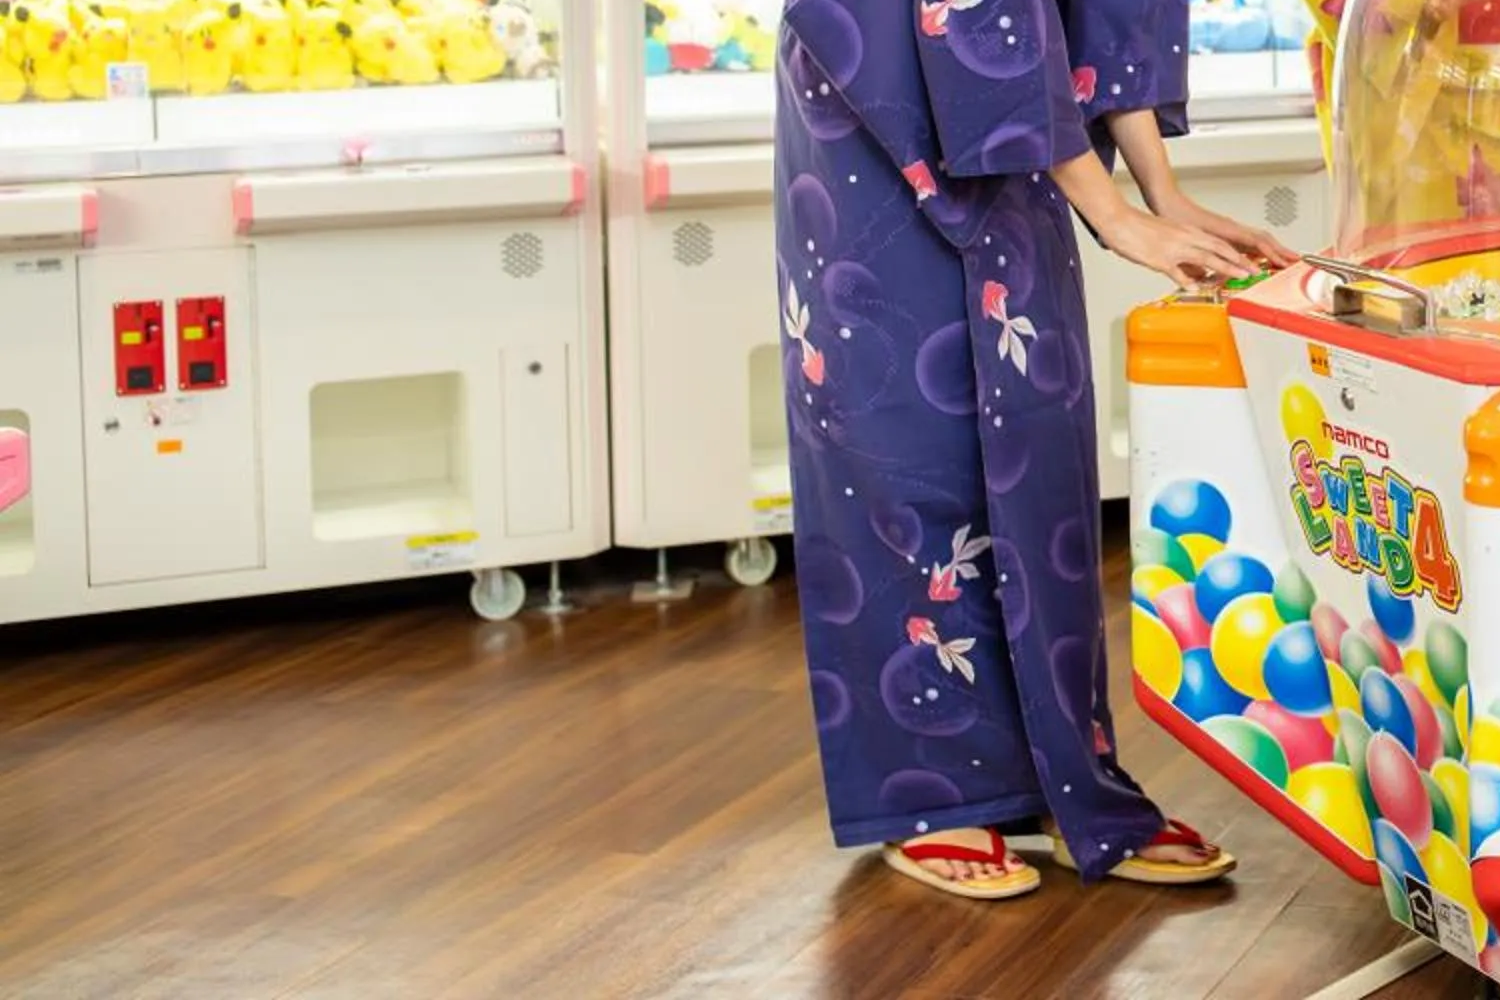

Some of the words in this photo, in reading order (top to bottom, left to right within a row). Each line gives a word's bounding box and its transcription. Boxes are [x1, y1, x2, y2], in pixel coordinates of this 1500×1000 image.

[1321, 421, 1390, 460] namco
[1294, 450, 1414, 538] SWEET
[1294, 494, 1415, 590] LAND
[1413, 497, 1459, 608] 4
